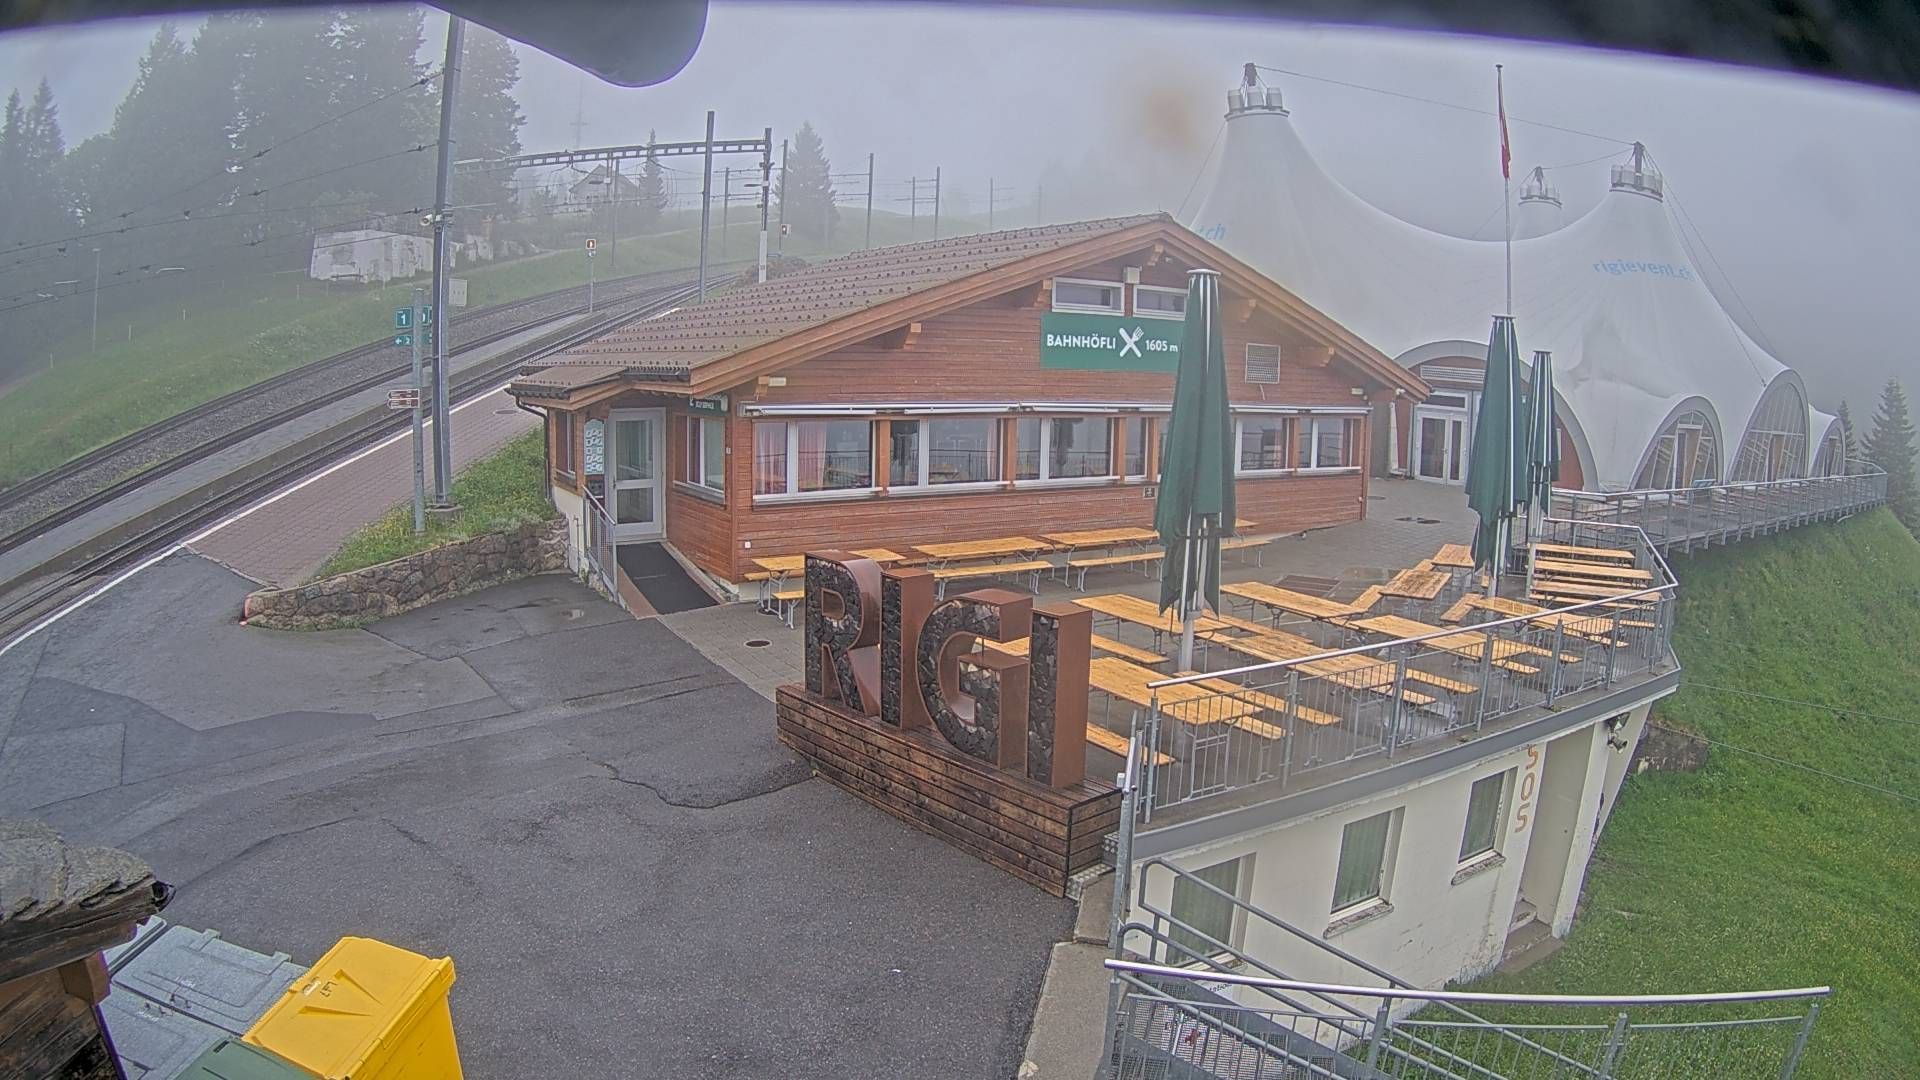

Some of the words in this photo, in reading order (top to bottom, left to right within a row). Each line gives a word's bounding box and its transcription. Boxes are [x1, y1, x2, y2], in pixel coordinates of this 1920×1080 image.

[401, 314, 406, 325] 1
[1046, 333, 1117, 350] BAHNHÖFLI
[1146, 340, 1168, 352] 1605
[1169, 344, 1179, 352] m
[805, 552, 1093, 788] RIGI
[1514, 744, 1538, 833] SOS
